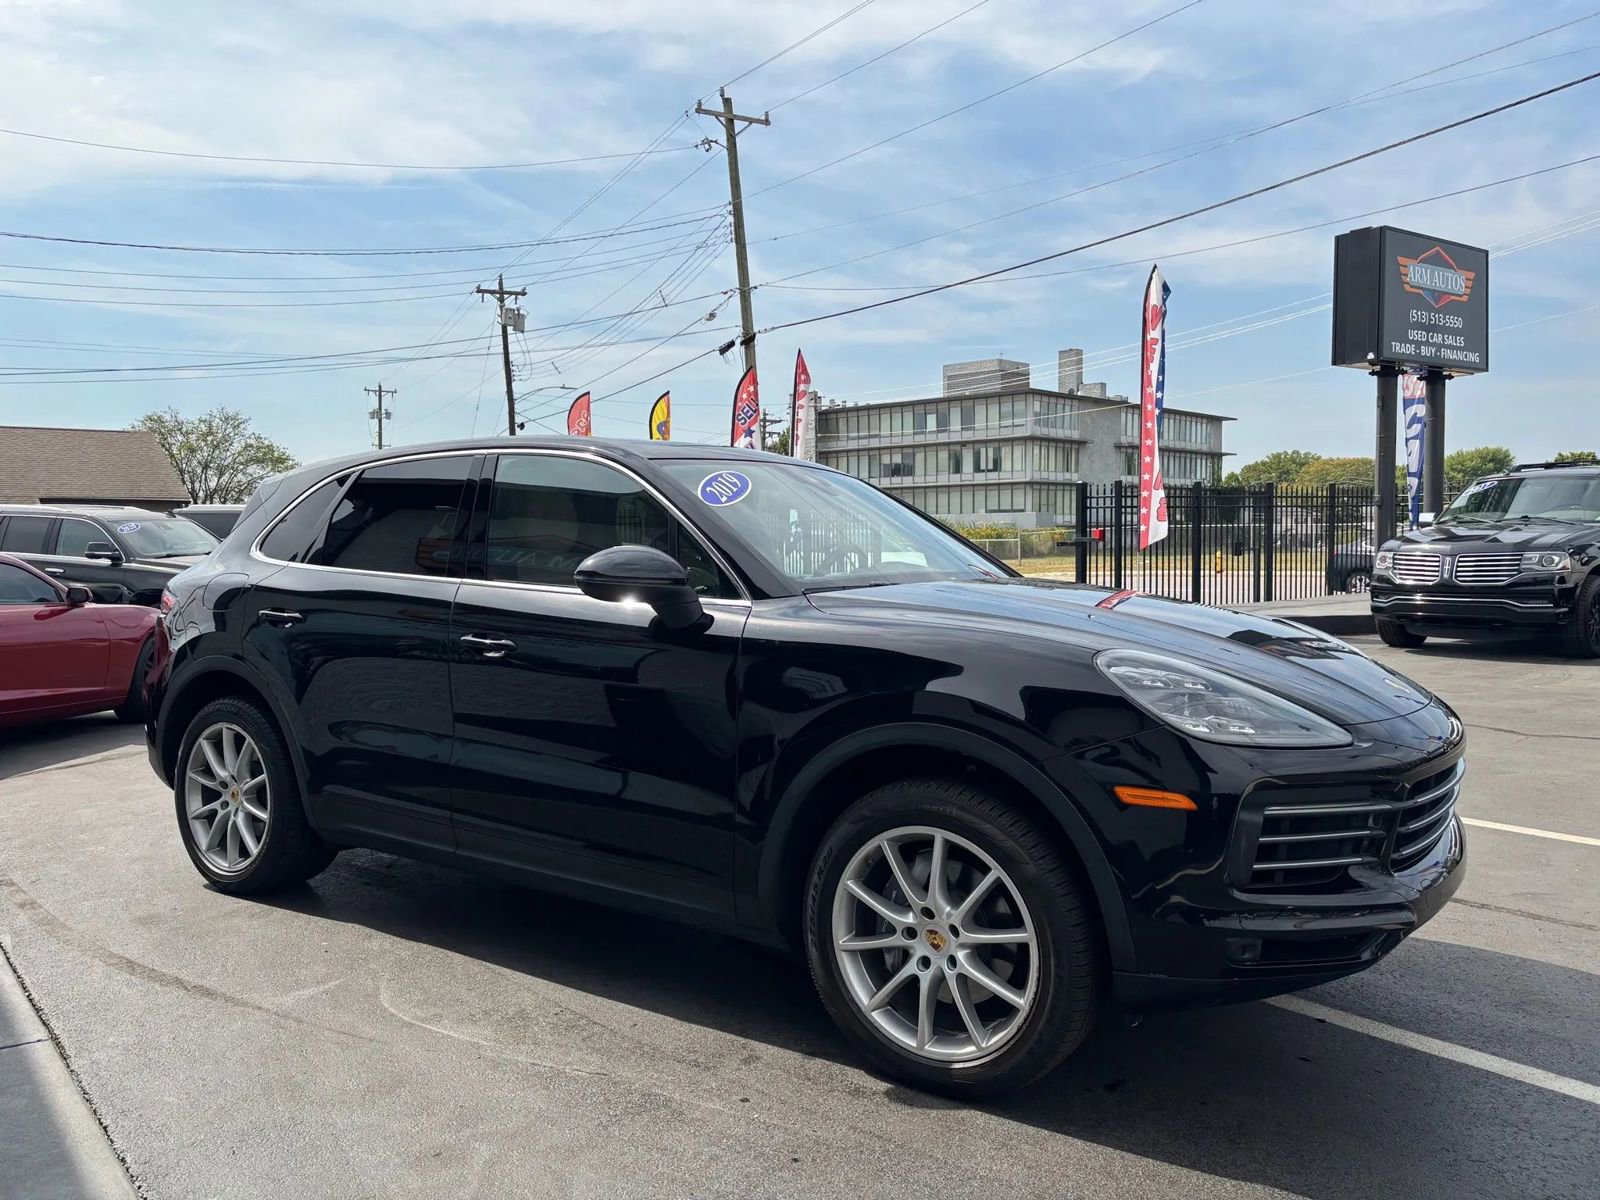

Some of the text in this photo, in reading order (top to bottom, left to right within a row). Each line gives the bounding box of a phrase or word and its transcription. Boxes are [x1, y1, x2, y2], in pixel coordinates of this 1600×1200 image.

[1407, 264, 1465, 292] ARM AUTOS
[1409, 309, 1463, 329] (513) 513-5550
[1408, 329, 1465, 347] USED CAR SALES
[1391, 341, 1416, 355] TRADE
[1420, 345, 1436, 358] BUY
[1441, 347, 1480, 363] FINANCING
[705, 472, 742, 503] 2019
